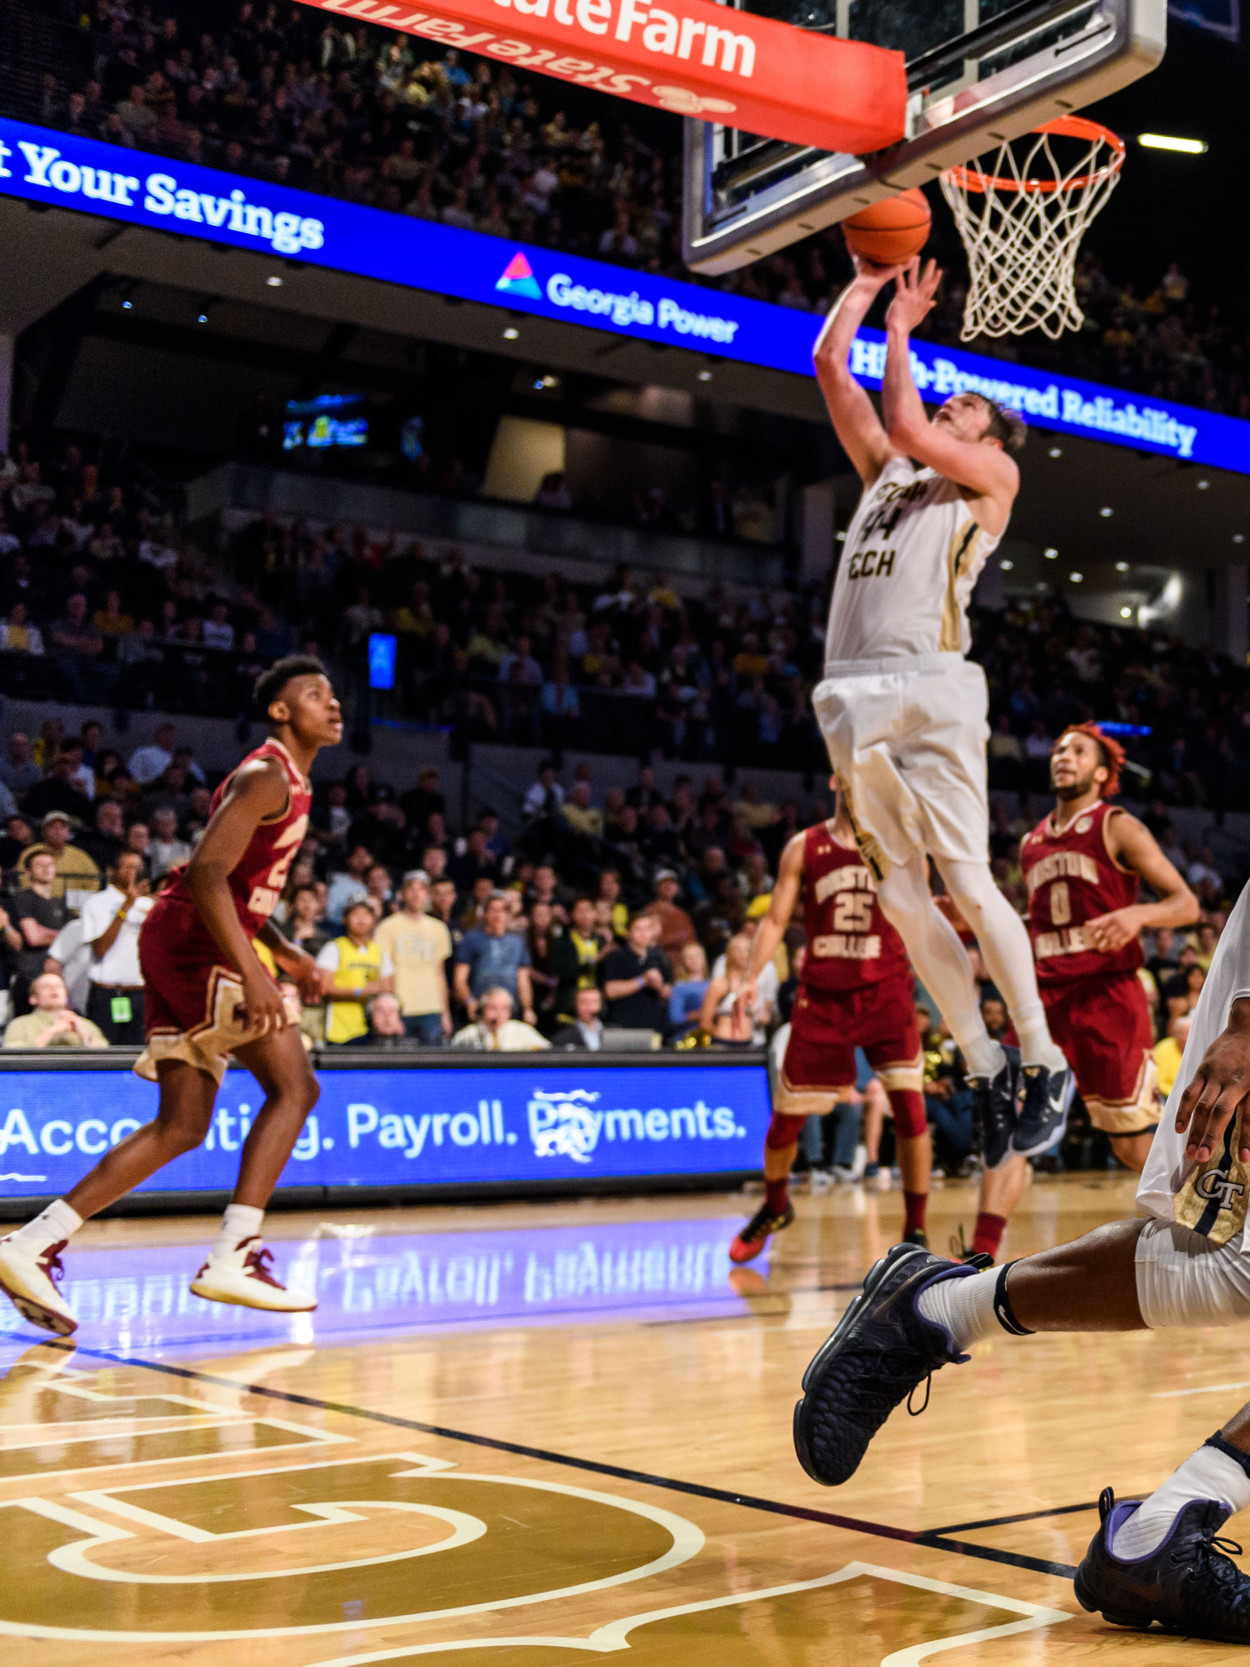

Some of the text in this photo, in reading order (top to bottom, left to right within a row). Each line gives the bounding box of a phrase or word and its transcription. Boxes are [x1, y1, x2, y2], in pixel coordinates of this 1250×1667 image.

[17, 140, 140, 206] Your
[144, 173, 325, 254] Savings
[547, 273, 739, 343] Georgia Power
[850, 338, 1197, 457] Hih-Powered Reliability
[834, 891, 873, 931] 25
[347, 1099, 518, 1159] Payroll.
[1195, 1168, 1245, 1210] GT
